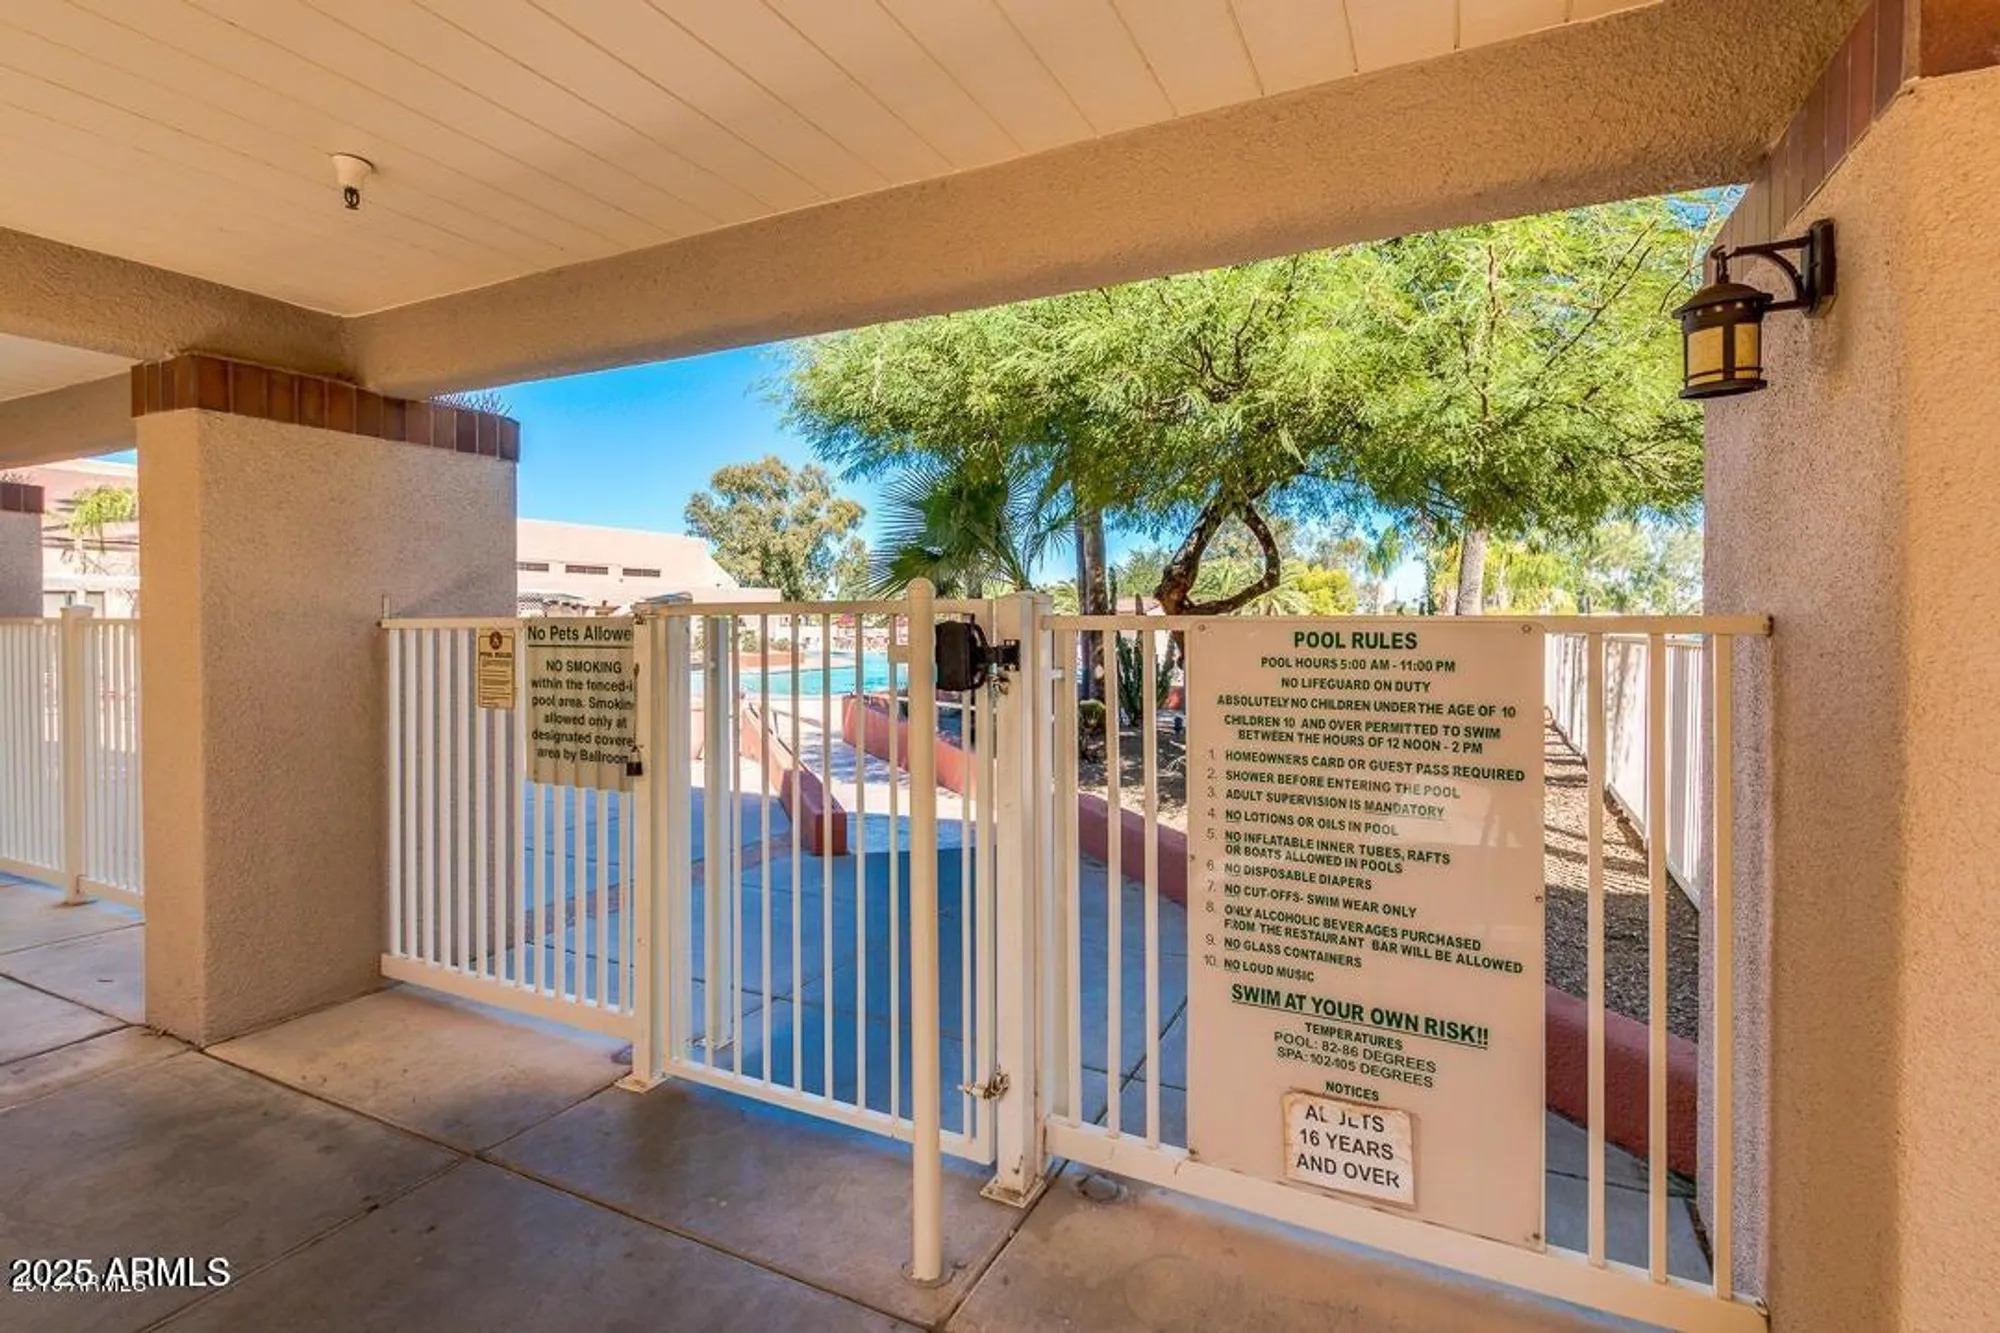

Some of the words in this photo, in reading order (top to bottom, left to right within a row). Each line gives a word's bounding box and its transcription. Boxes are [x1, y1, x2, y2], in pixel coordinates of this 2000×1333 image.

[528, 626, 545, 640] No
[550, 626, 579, 640] Pets
[584, 626, 634, 640] Allowe
[1294, 632, 1346, 649] POOL
[1352, 632, 1417, 649] RULES
[546, 660, 562, 671] NO
[567, 661, 621, 673] SMOKING
[1261, 657, 1292, 668] POOL
[1295, 658, 1338, 669] HOURS
[1340, 659, 1366, 669] 5:00
[1371, 660, 1390, 670] AM
[1401, 661, 1432, 671] 11:00
[1436, 661, 1456, 672] PM
[531, 678, 562, 688] within
[566, 679, 583, 689] the
[587, 680, 633, 691] fenced-i
[1281, 678, 1298, 688] NO
[1301, 678, 1370, 690] LIFEGUARD
[1374, 680, 1391, 691] ON
[1396, 682, 1431, 692] DUTY
[532, 695, 555, 709] pool
[589, 697, 635, 710] Smokin
[1217, 695, 1291, 707] ABSOLUTELY
[1291, 698, 1308, 708] NO
[1311, 698, 1370, 711] CHILDREN
[1374, 702, 1416, 713] UNDER
[1419, 704, 1443, 714] THE
[1448, 705, 1475, 716] AGE
[1478, 706, 1496, 716] OF
[1502, 707, 1516, 718] 10
[544, 712, 584, 725] allowed
[589, 714, 612, 730] only
[616, 718, 627, 728] at
[1224, 715, 1280, 727] CHILDREN
[1284, 718, 1295, 728] 10
[1301, 719, 1326, 729] AND
[1329, 720, 1362, 731] OVER
[1365, 722, 1438, 735] PERMITTED
[1443, 726, 1460, 736] TO
[1464, 726, 1501, 738] SWIM
[532, 729, 591, 744] designated
[595, 735, 635, 747] covere
[1238, 730, 1293, 742] BETWEEN
[1297, 733, 1319, 744] THE
[1323, 734, 1364, 746] HOURS
[1368, 737, 1384, 747] OF
[1387, 738, 1399, 749] 12
[1403, 739, 1440, 750] NOON
[1452, 741, 1459, 752] 2
[1463, 742, 1483, 753] PM
[537, 748, 560, 758] area
[563, 749, 576, 763] by
[1226, 751, 1309, 766] HOMEOWNERS
[1312, 756, 1345, 768] CARD
[1348, 759, 1365, 769] OR
[1369, 760, 1412, 773] GUEST
[1416, 763, 1449, 776] PASS
[1452, 766, 1525, 781] REQUIRED
[1226, 770, 1274, 783] SHOWER
[1278, 774, 1324, 788] BEFORE
[1328, 777, 1391, 793] ENTERING
[1395, 783, 1420, 794] THE
[1424, 785, 1460, 799] POOL
[1226, 789, 1263, 801] ADULT
[1266, 792, 1346, 809] SUPERVISION
[1350, 799, 1361, 810] IS
[1364, 800, 1445, 817] MANDATORY
[1226, 810, 1241, 820] NO
[1244, 812, 1294, 825] LOTIONS
[1297, 817, 1314, 827] OR
[1317, 818, 1345, 830] OILS
[1348, 822, 1361, 832] IN
[1364, 823, 1399, 836] POOL
[1225, 831, 1241, 842] NO
[1244, 832, 1314, 849] INFLATABLE
[1317, 839, 1355, 854] INNER
[1359, 844, 1405, 861] TUBES,
[1408, 850, 1451, 865] RAFTS
[1226, 845, 1241, 855] OR
[1244, 846, 1282, 860] BOATS
[1285, 851, 1341, 866] ALLOWED
[1345, 858, 1357, 868] IN
[1361, 859, 1403, 874] POOLS
[1224, 863, 1241, 874] NO
[1244, 865, 1316, 883] DISPOSABLE
[1319, 875, 1372, 890] DIAPERS
[1224, 884, 1241, 894] NO
[1307, 894, 1339, 907] SWIM
[1343, 899, 1379, 913] WEAR
[1382, 903, 1417, 918] ONLY
[1224, 904, 1252, 917] ONLY
[1254, 908, 1320, 927] ALCOHOLIC
[1323, 918, 1398, 938] BEVERAGES
[1401, 929, 1481, 951] PURCHASED
[1224, 918, 1255, 932] FROM
[1260, 923, 1282, 937] THE
[1285, 927, 1365, 948] RESTAURANT
[1372, 940, 1397, 954] BAR
[1401, 945, 1432, 959] WILL
[1435, 950, 1452, 962] BE
[1456, 954, 1523, 974] ALLOWED
[1224, 938, 1241, 949] NO
[1243, 941, 1281, 955] GLASS
[1284, 946, 1362, 968] CONTAINERS
[1224, 959, 1240, 969] NO
[1243, 962, 1274, 975] LOUD
[1276, 968, 1314, 982] MUSIC
[1232, 984, 1280, 1007] SWIM
[1285, 993, 1306, 1011] AT
[1312, 997, 1364, 1022] YOUR
[1371, 1008, 1418, 1032] OWN
[1425, 1017, 1488, 1045] RISK!!
[1305, 1022, 1403, 1050] TEMPERATURES
[1274, 1031, 1318, 1049] POOL:
[1322, 1041, 1358, 1057] 82-86
[1363, 1049, 1437, 1073] DEGREES
[1277, 1047, 1308, 1062] SPA:
[1360, 1063, 1433, 1088] DEGREES
[1326, 1081, 1379, 1101] NOTICES
[1300, 1128, 1319, 1146] 16
[1326, 1132, 1394, 1160] YEARS
[1297, 1154, 1336, 1175] AND
[1343, 1163, 1400, 1188] OVER
